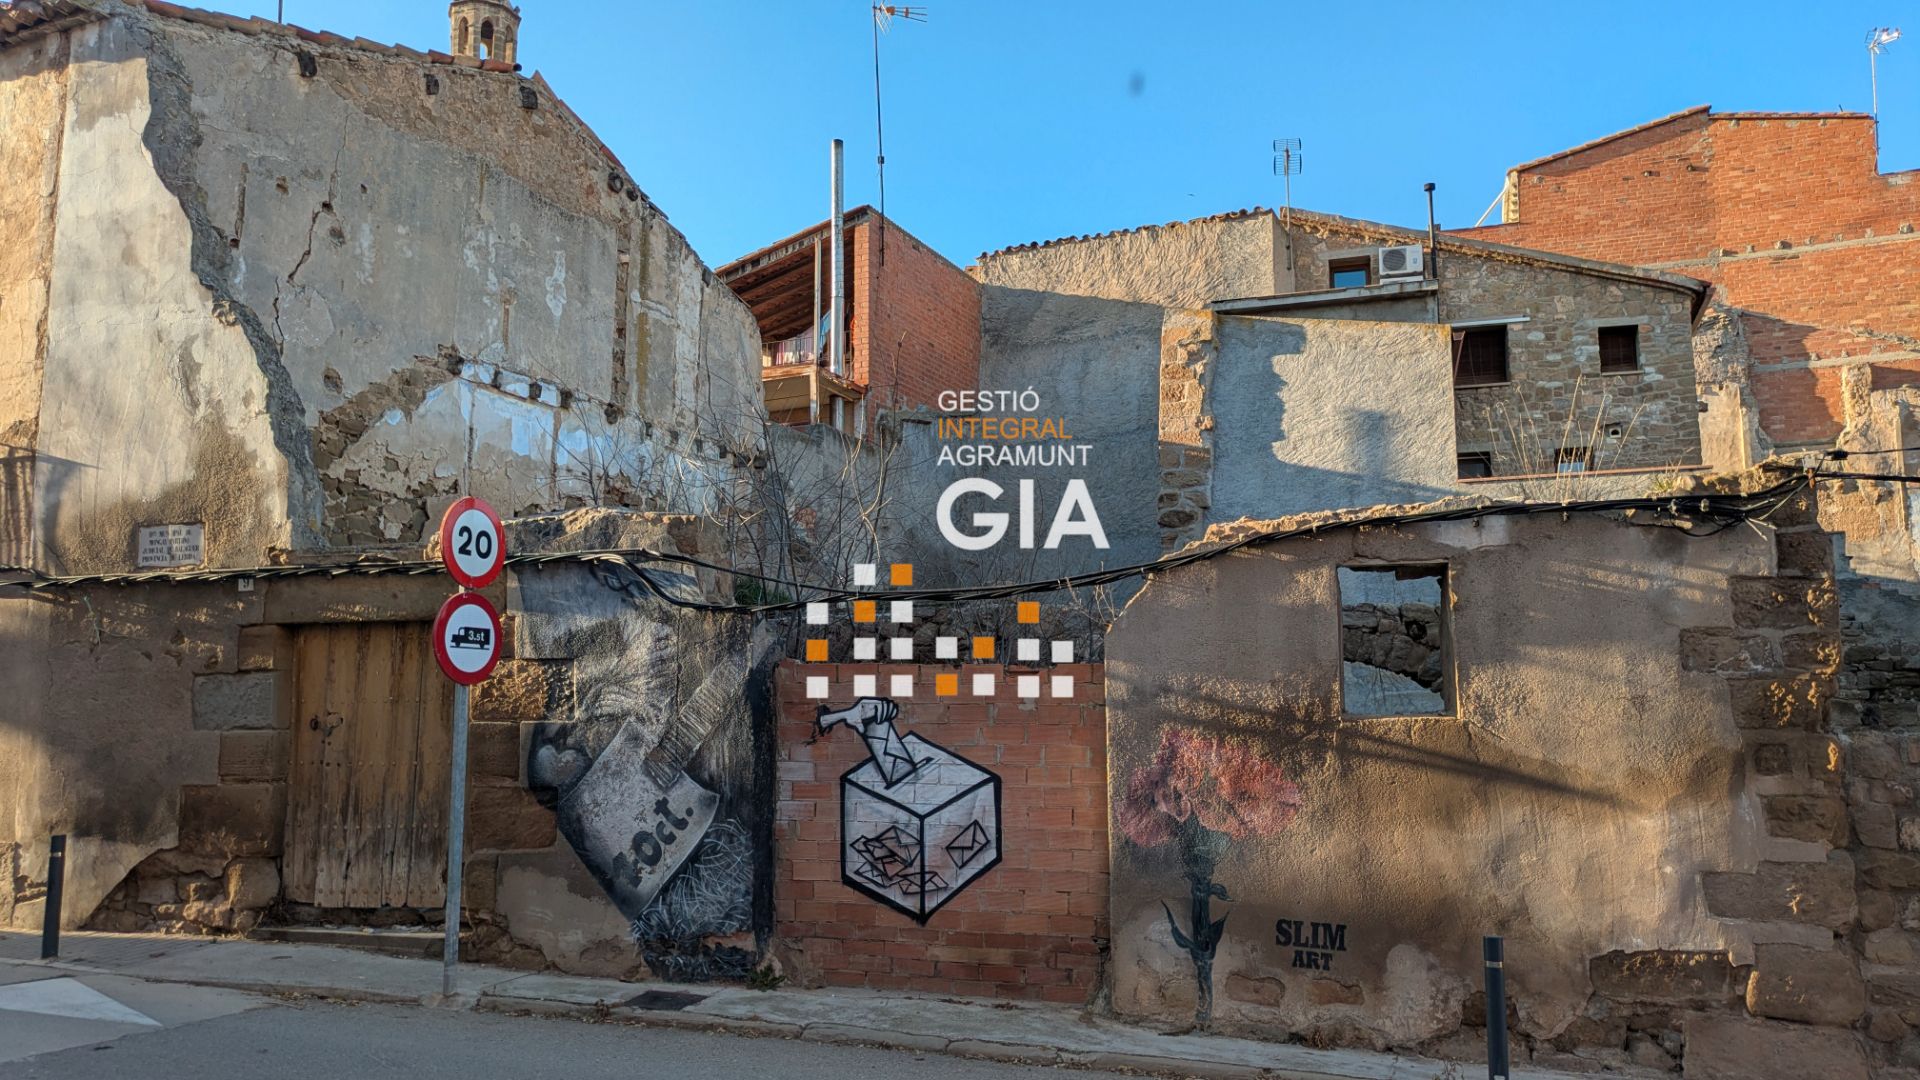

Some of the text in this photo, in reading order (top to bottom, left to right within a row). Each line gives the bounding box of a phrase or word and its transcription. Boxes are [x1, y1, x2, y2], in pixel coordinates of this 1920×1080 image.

[458, 525, 493, 559] 20
[468, 630, 485, 641] 3.5t
[1275, 918, 1347, 951] SLIM
[1292, 950, 1333, 971] ART
